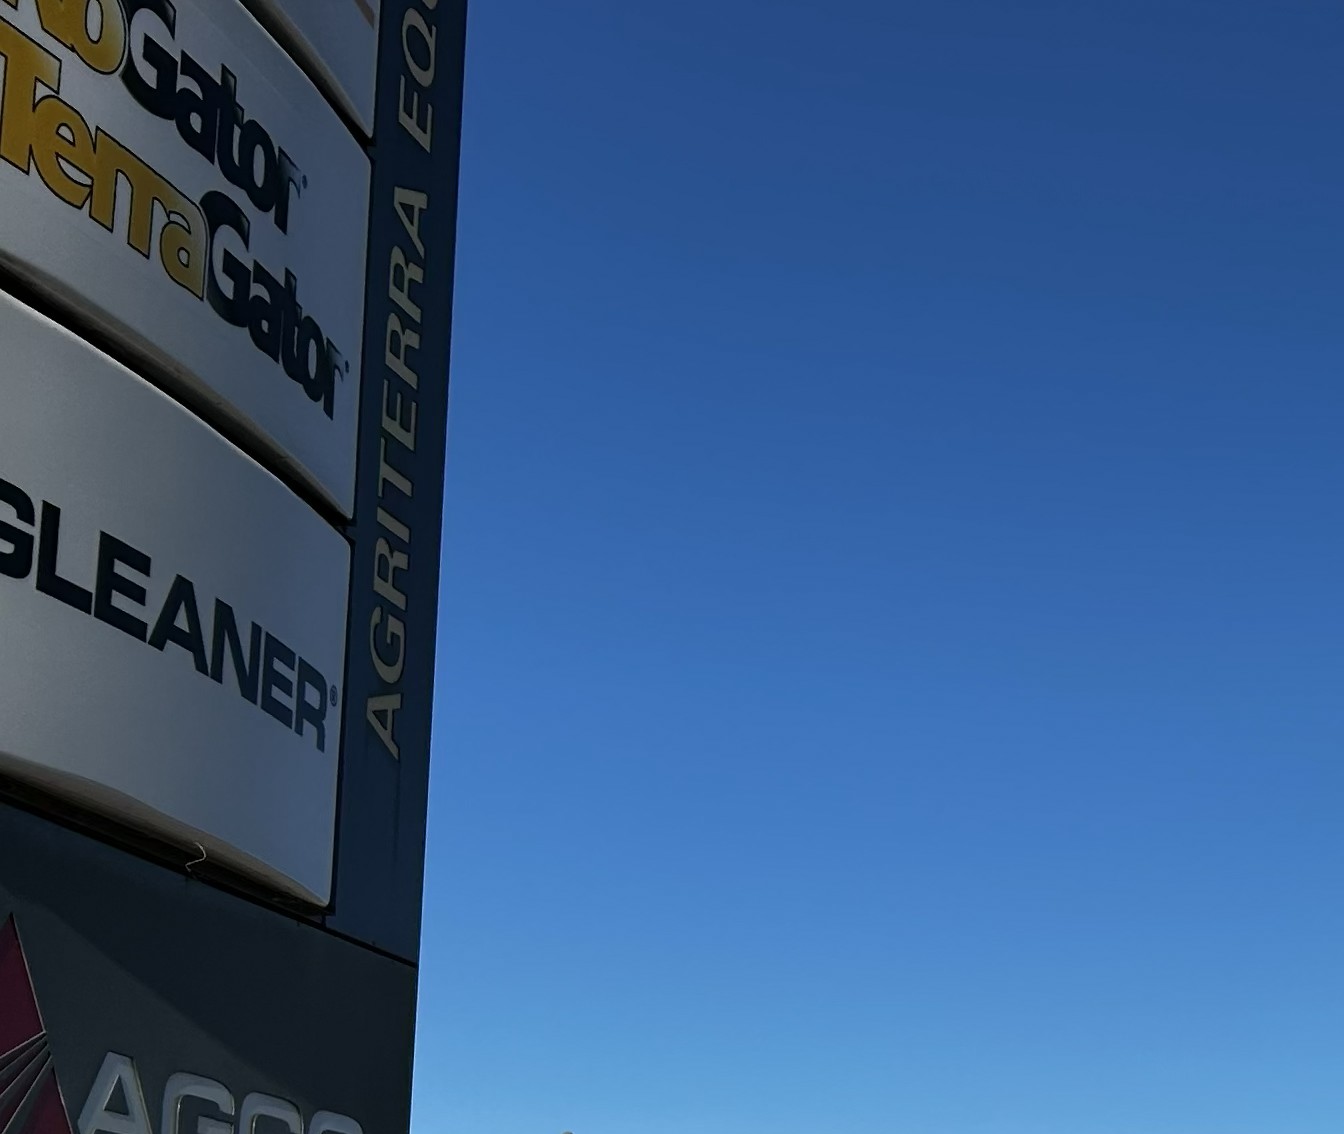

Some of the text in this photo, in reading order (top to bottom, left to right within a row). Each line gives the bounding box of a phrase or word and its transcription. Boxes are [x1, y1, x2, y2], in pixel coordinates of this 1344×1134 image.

[0, 0, 302, 235] oGator
[399, 0, 437, 154] EQ
[366, 186, 430, 760] AGRITERRA
